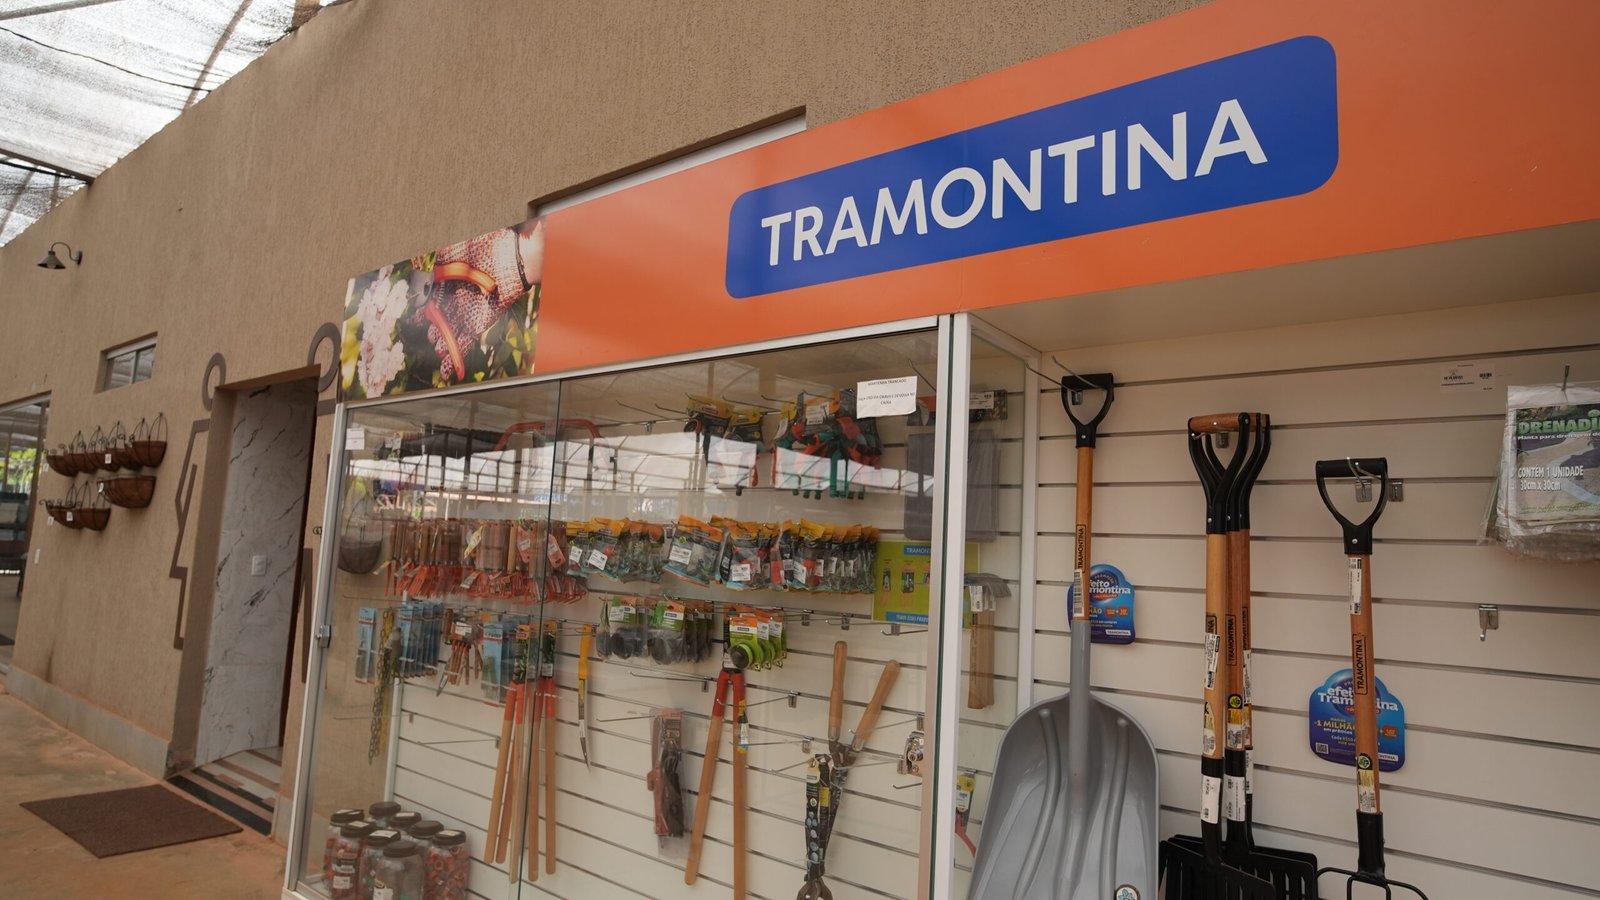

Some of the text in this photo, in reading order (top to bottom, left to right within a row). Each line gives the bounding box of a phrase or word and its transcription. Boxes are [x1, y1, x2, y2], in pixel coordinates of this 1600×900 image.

[761, 98, 1268, 266] TRAMONTINA
[1518, 464, 1545, 478] CONTÉM
[1552, 464, 1584, 478] UNIDADE
[1520, 480, 1536, 490] 30cm
[1543, 480, 1561, 490] 30cm
[1089, 585, 1131, 594] montina
[1327, 686, 1354, 698] efei
[1318, 692, 1398, 711] Tramina
